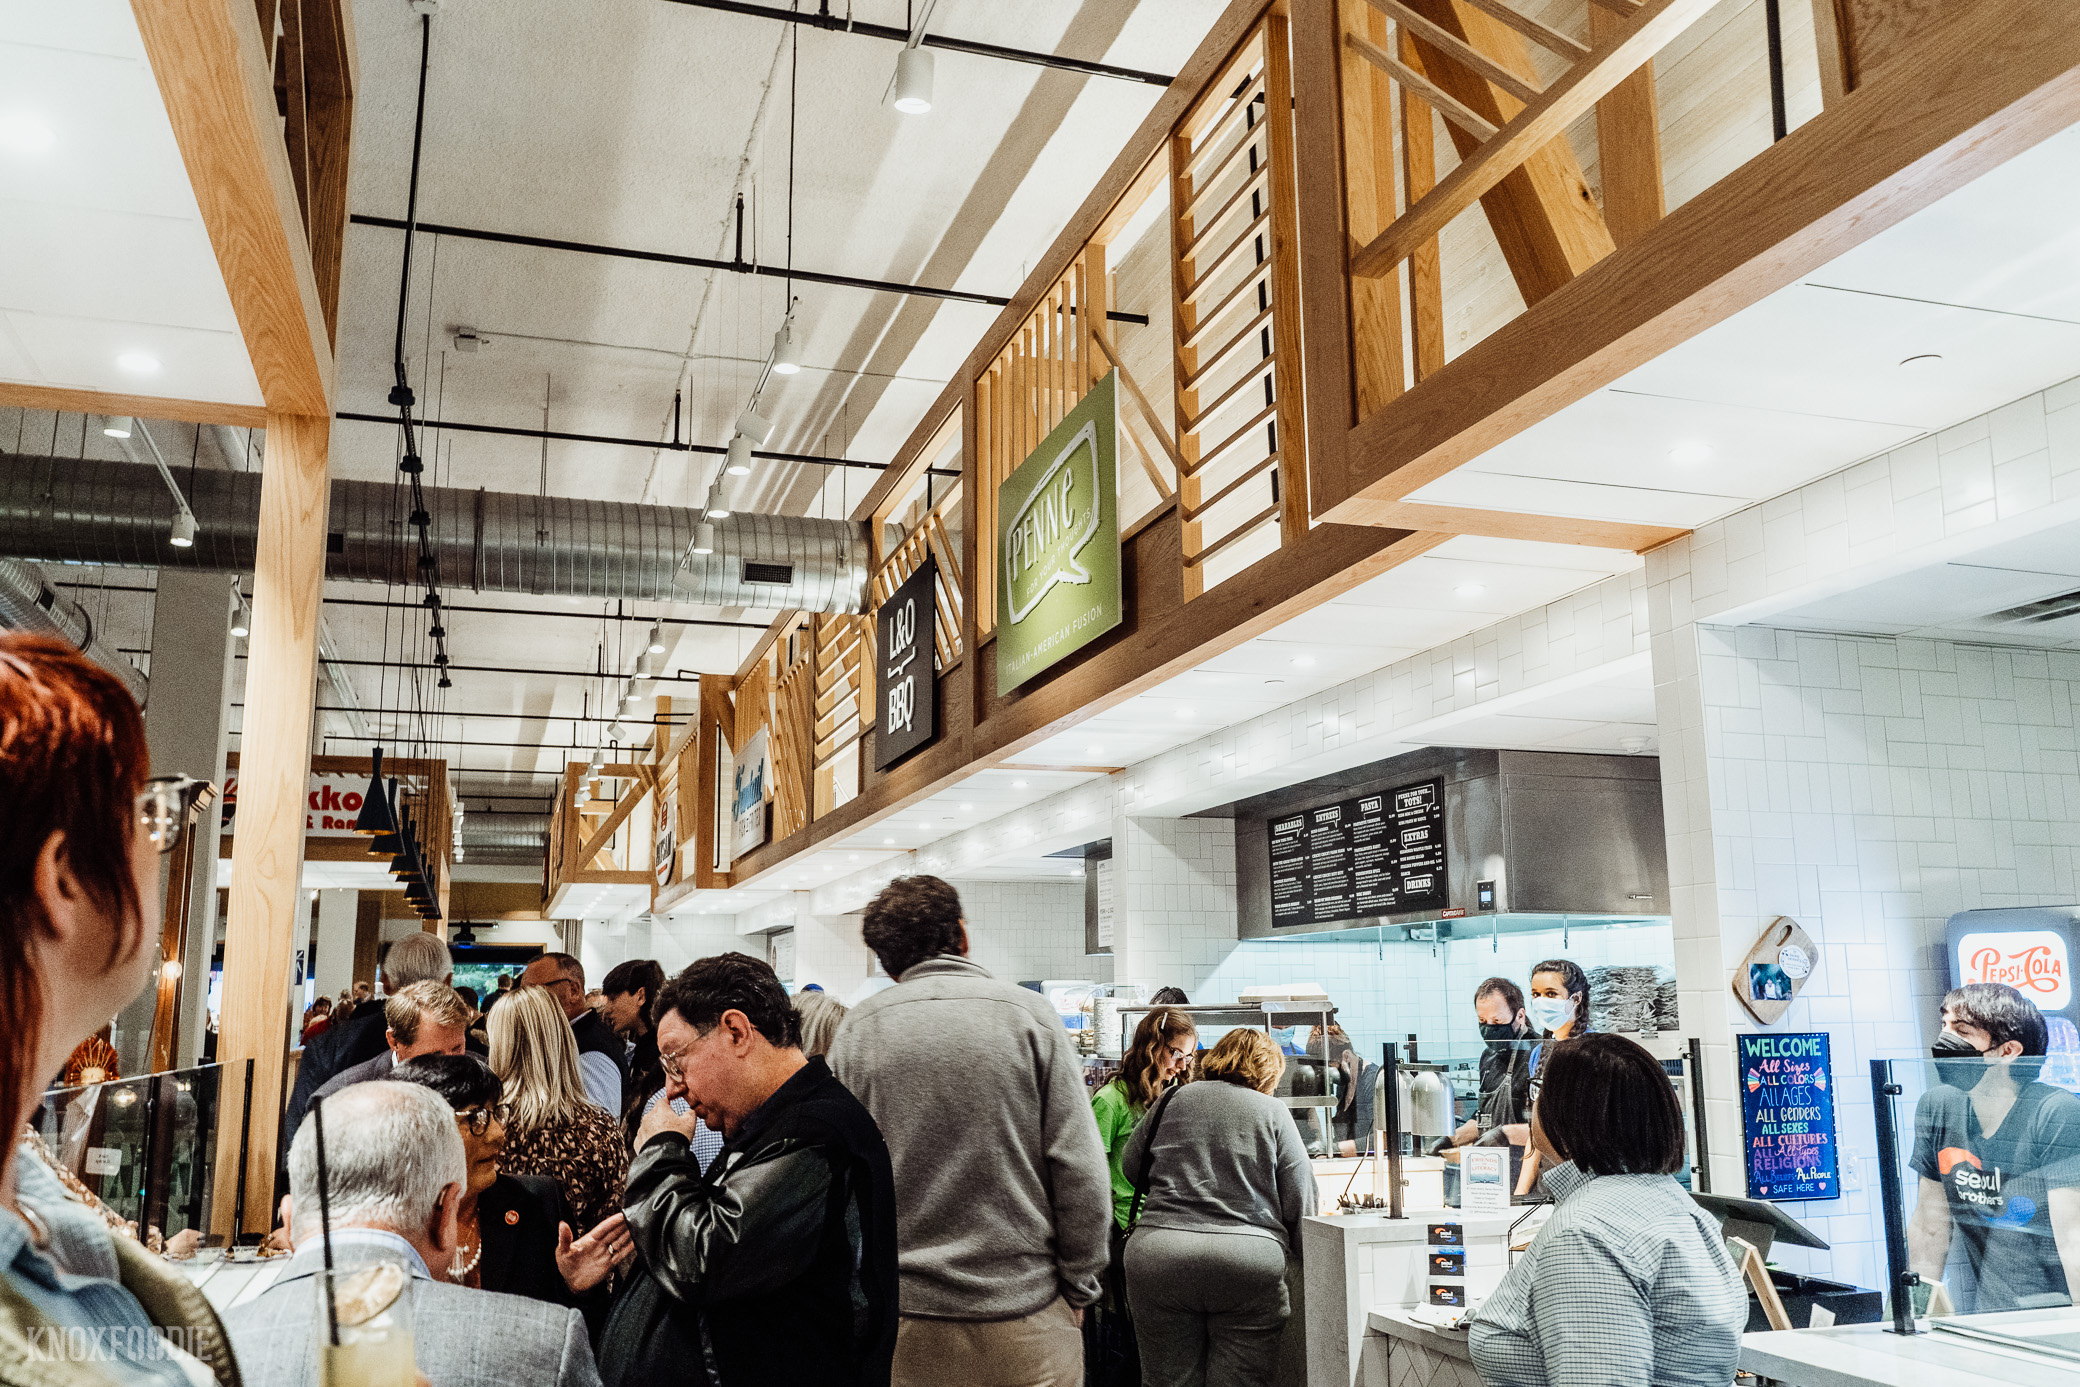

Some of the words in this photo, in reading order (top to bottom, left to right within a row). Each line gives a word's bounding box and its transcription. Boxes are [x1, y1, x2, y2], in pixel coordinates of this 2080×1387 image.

[1026, 577, 1038, 598] FOR
[1040, 554, 1056, 577] YOUR
[1056, 507, 1091, 556] THOUGHTS
[1072, 603, 1102, 633] FUSION
[889, 598, 915, 660] L&O
[888, 675, 914, 735] BBQ
[308, 785, 364, 812] kko
[1360, 800, 1379, 813] PASTA
[1404, 795, 1423, 808] TOTS!
[1315, 809, 1339, 823] ENTREES
[1403, 829, 1429, 843] EXTRAS
[1406, 878, 1432, 890] DRINKS
[1745, 1037, 1822, 1058] WELCOME
[1758, 1058, 1780, 1073] All
[1783, 1058, 1810, 1076] Sizes
[1760, 1075, 1780, 1086] ALL
[1780, 1073, 1815, 1085] COLORS
[1780, 1085, 1812, 1107] AGES
[1755, 1108, 1777, 1123] ALL
[1761, 1123, 1780, 1135] ALL
[1781, 1122, 1809, 1134] SEXES
[1753, 1136, 1775, 1148] ALL
[1777, 1132, 1828, 1146] CULTURES
[1754, 1156, 1822, 1171] RELIGIONS
[1955, 1166, 2000, 1193] seoul
[1772, 1184, 1793, 1194] SAFE
[1796, 1182, 1815, 1192] HERE
[1955, 1185, 2004, 1206] brothers
